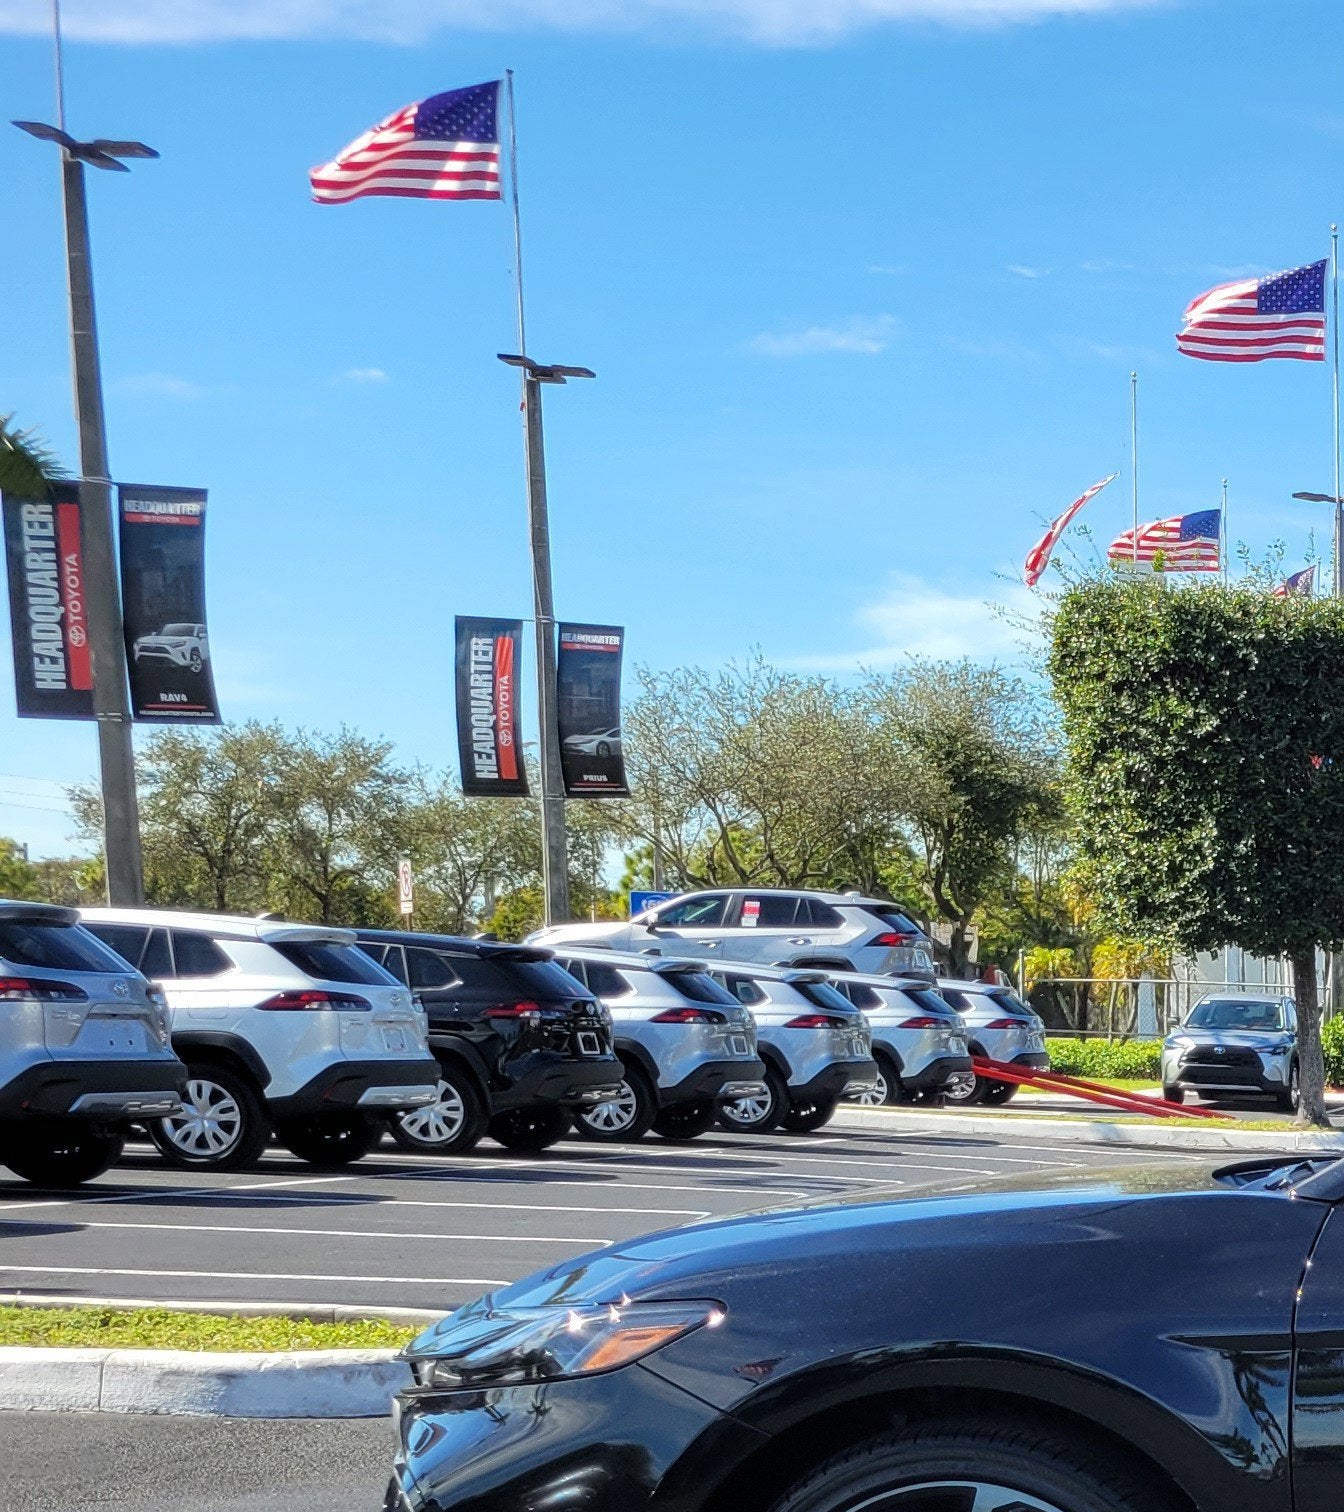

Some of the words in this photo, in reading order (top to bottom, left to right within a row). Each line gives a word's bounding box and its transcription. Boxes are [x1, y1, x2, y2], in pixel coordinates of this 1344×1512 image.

[21, 503, 67, 690] HEADQUARTER
[65, 553, 81, 622] TOYOTA
[160, 692, 188, 702] RAV4
[470, 636, 499, 780] HEADQUARTER
[499, 675, 510, 727] TOYOTA
